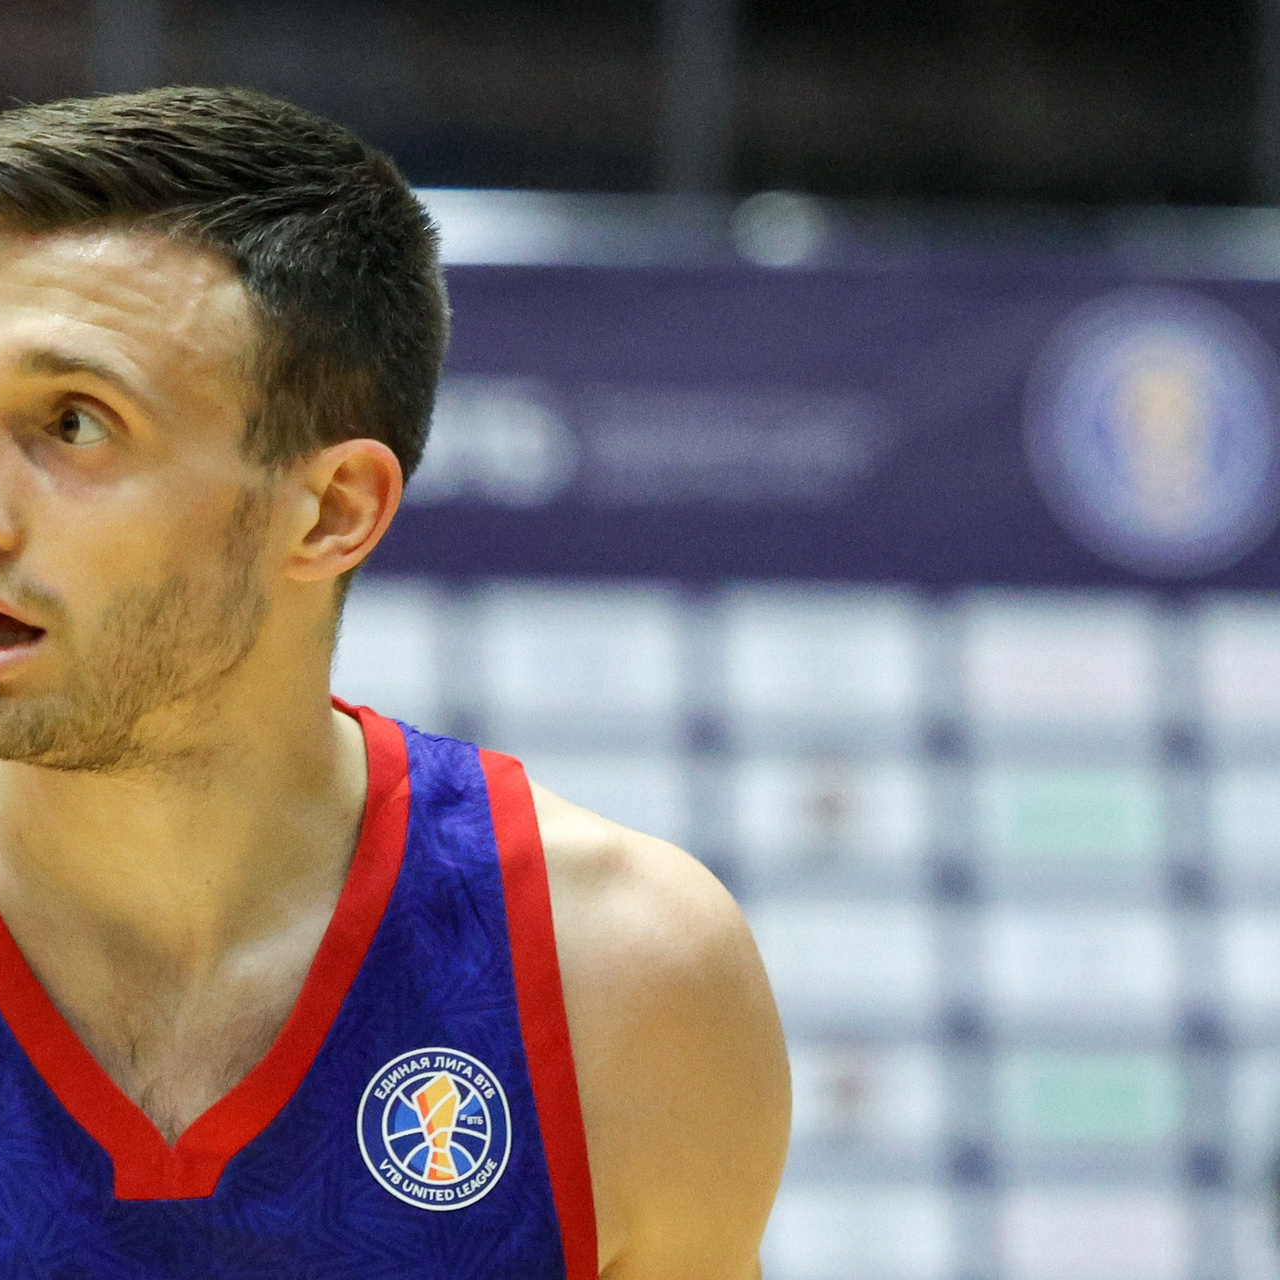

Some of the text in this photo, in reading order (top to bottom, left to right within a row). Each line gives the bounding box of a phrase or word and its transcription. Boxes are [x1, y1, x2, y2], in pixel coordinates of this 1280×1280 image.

[374, 1056, 496, 1100] ЕДИНАЯ ЛИГА ВТБ
[379, 1158, 498, 1202] VTB UNITED LEAGUE
